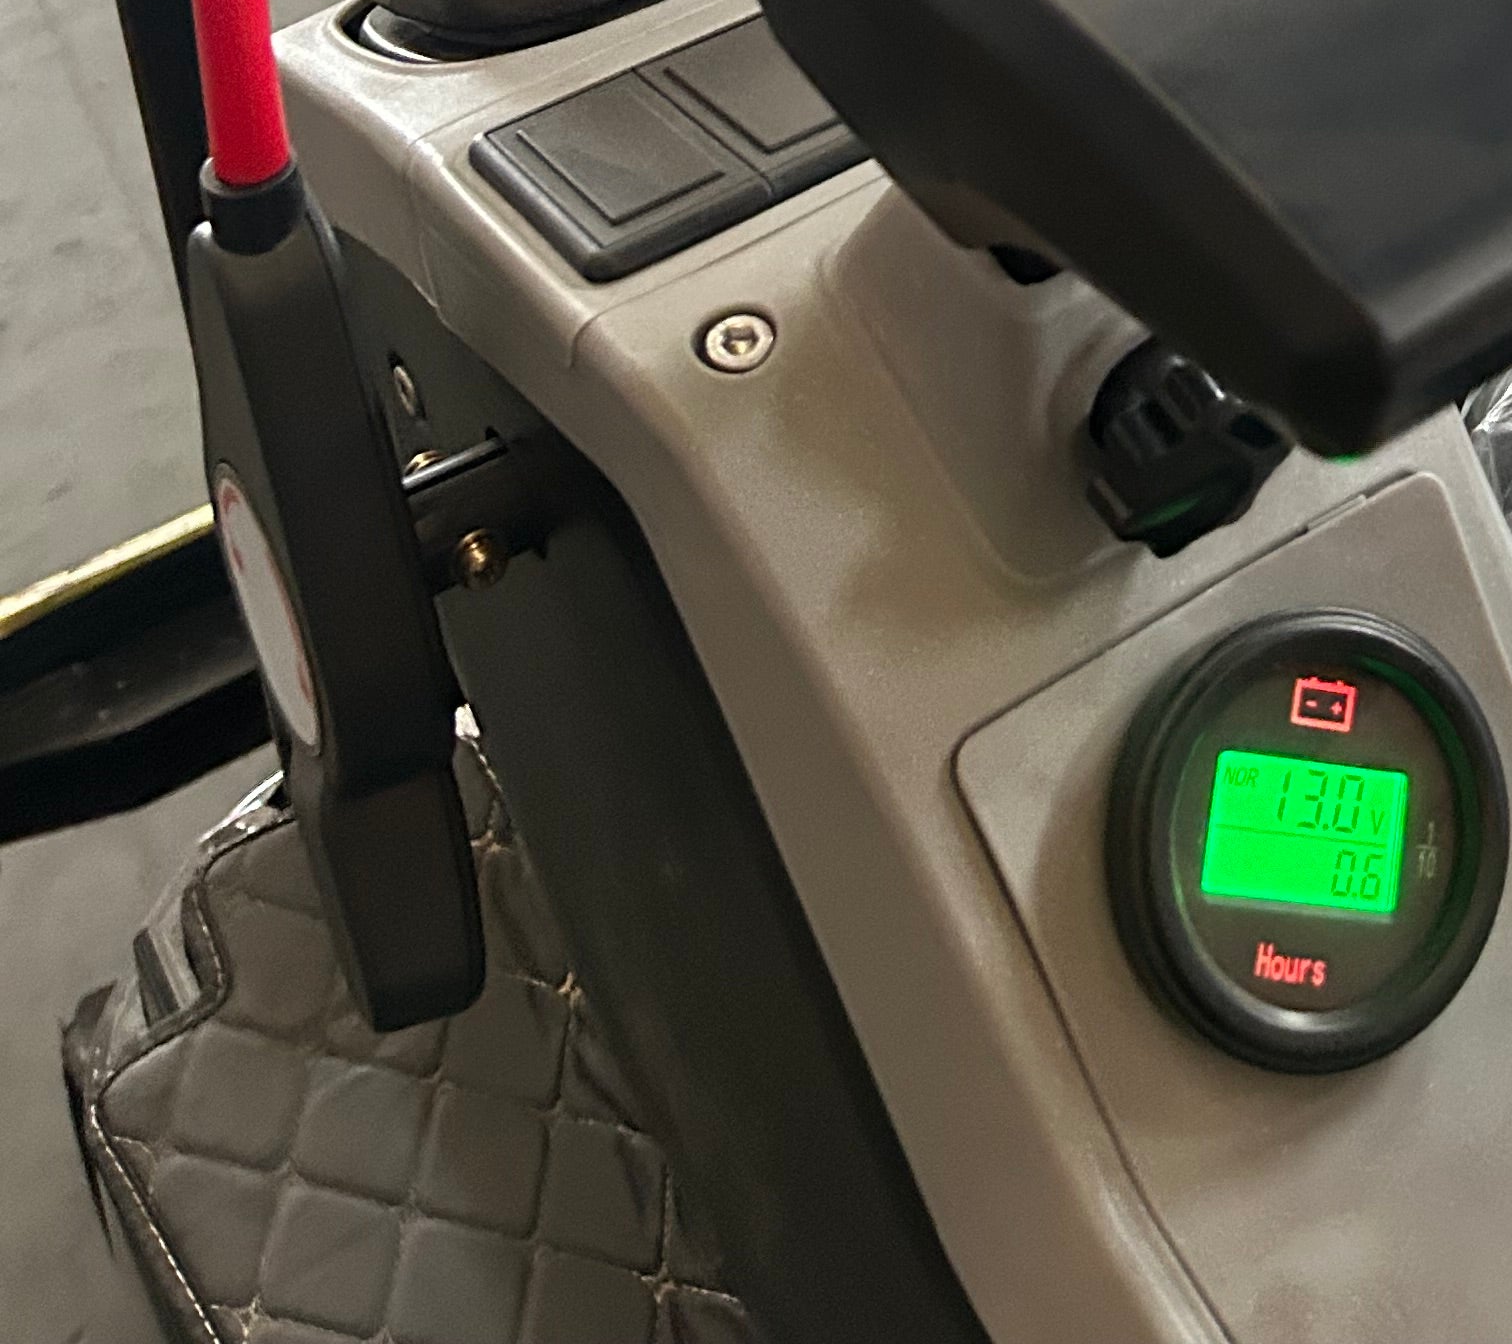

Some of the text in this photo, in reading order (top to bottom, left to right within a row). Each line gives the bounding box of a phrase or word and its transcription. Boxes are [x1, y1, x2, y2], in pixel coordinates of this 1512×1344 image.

[1223, 767, 1384, 835] NOR 13.0 V
[1331, 849, 1383, 900] 0.6
[1255, 942, 1327, 987] Hours
